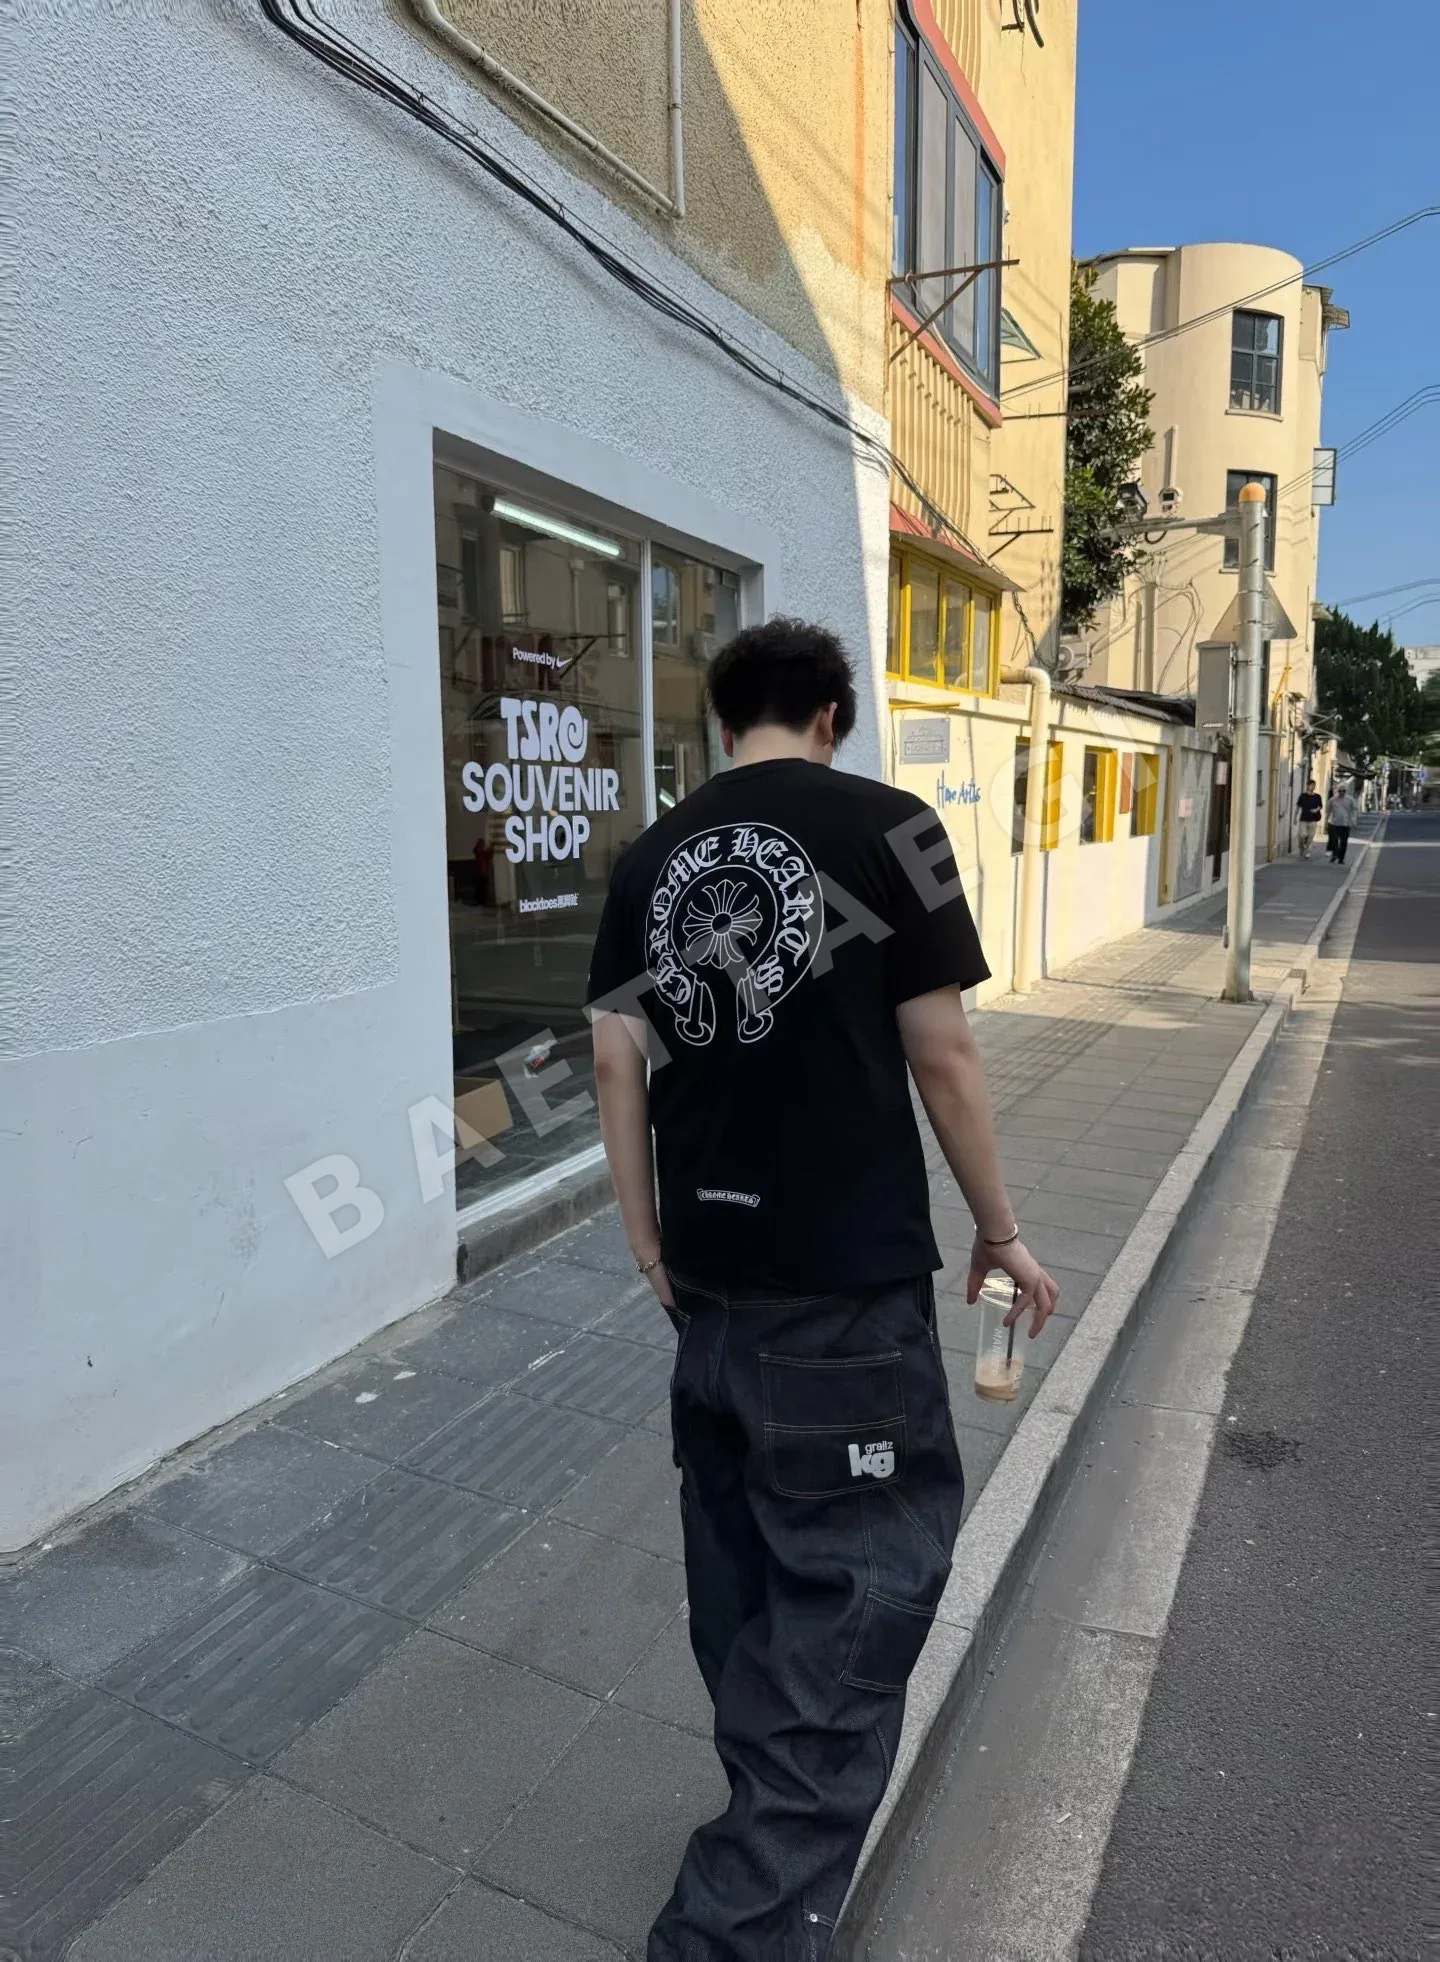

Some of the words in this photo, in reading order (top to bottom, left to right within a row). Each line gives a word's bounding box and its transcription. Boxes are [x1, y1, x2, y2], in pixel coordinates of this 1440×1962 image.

[512, 646, 546, 664] Powered
[546, 653, 556, 669] by
[462, 761, 620, 812] SOUVENIR
[505, 815, 589, 863] SHOP
[650, 836, 723, 1005] CHROME
[728, 827, 814, 996] HEARTS
